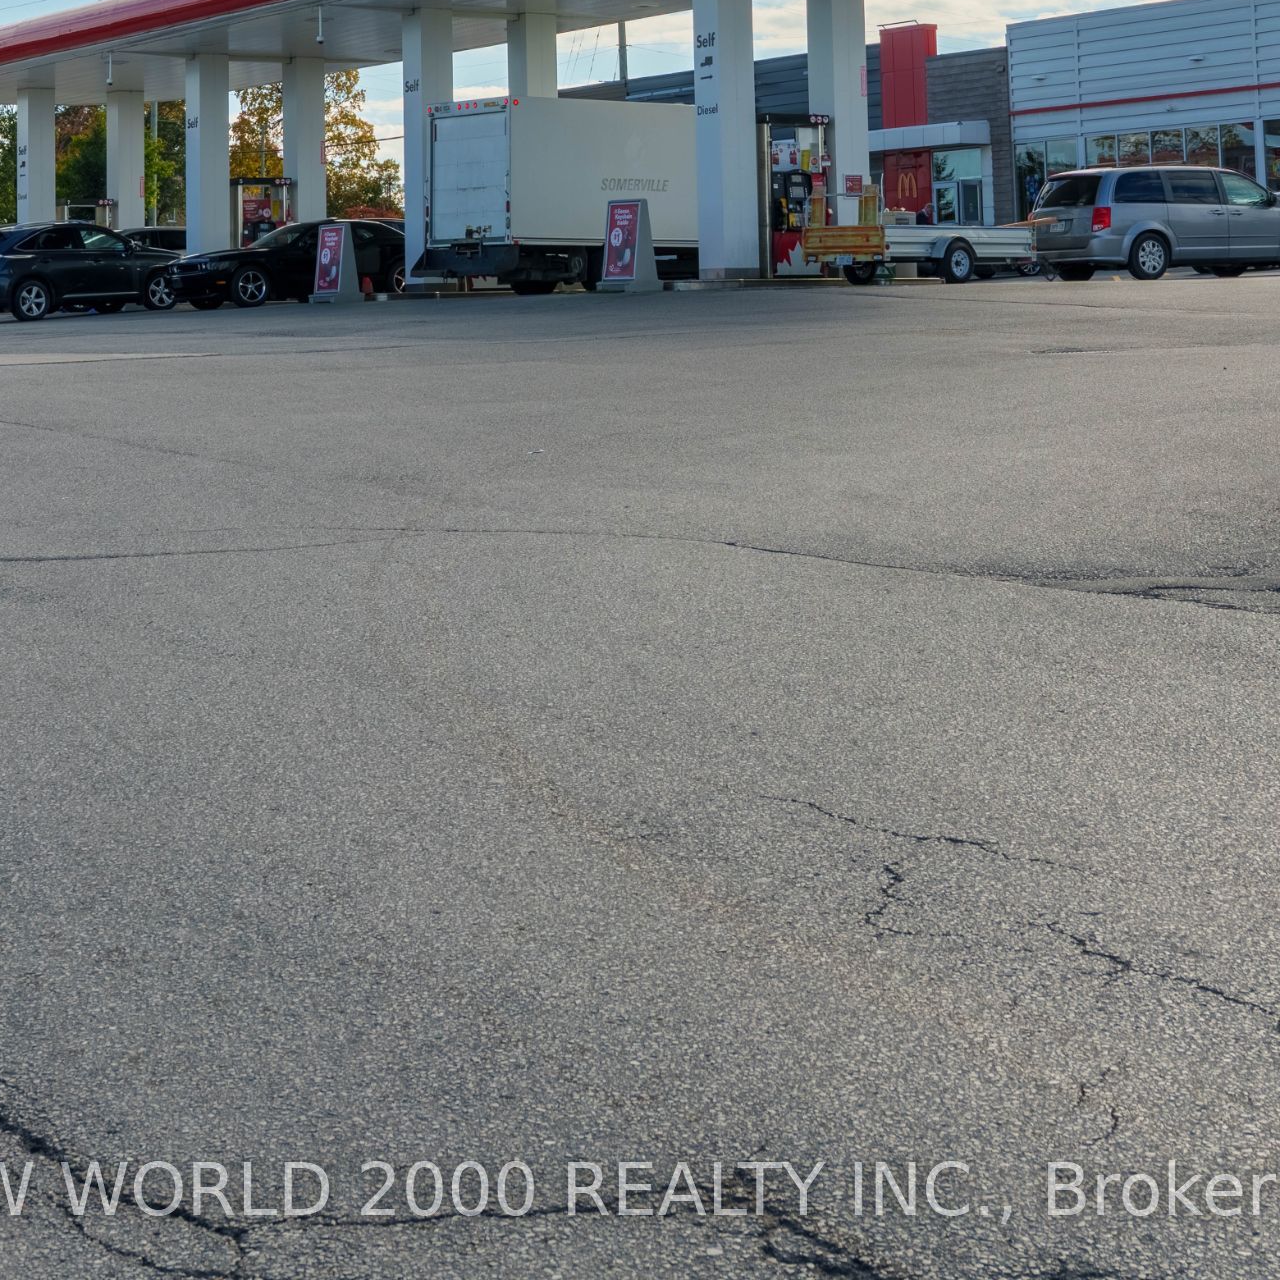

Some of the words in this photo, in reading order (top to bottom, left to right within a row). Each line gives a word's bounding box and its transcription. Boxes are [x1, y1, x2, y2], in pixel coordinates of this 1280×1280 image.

[696, 32, 715, 48] Self
[405, 79, 419, 93] Self
[697, 104, 718, 116] Diesel
[187, 116, 198, 129] Self
[600, 178, 669, 192] SOMERVILLE
